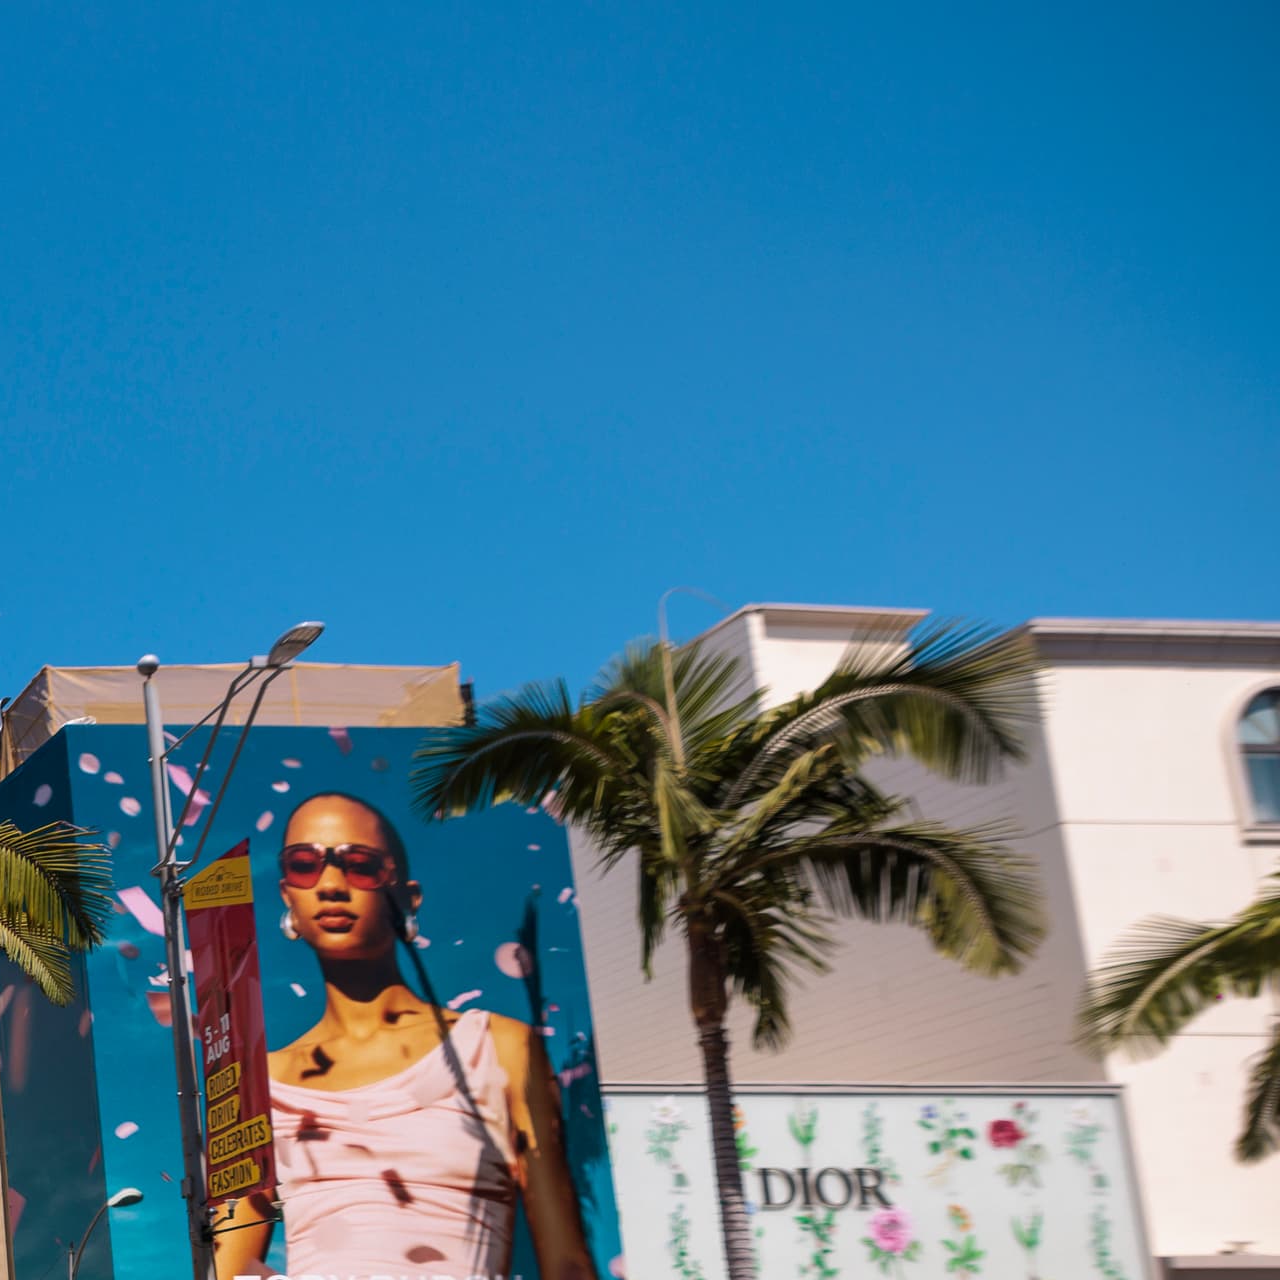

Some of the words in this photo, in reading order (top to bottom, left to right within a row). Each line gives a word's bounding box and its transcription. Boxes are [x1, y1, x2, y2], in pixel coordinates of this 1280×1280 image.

[205, 1026, 213, 1045] 5
[220, 1013, 230, 1034] 11
[206, 1035, 231, 1065] AUG
[209, 1066, 237, 1099] RODEO
[210, 1099, 236, 1130] DRIVE
[210, 1120, 266, 1160] CELEBRATES
[210, 1162, 253, 1193] FASHION
[756, 1167, 894, 1211] DIOR
